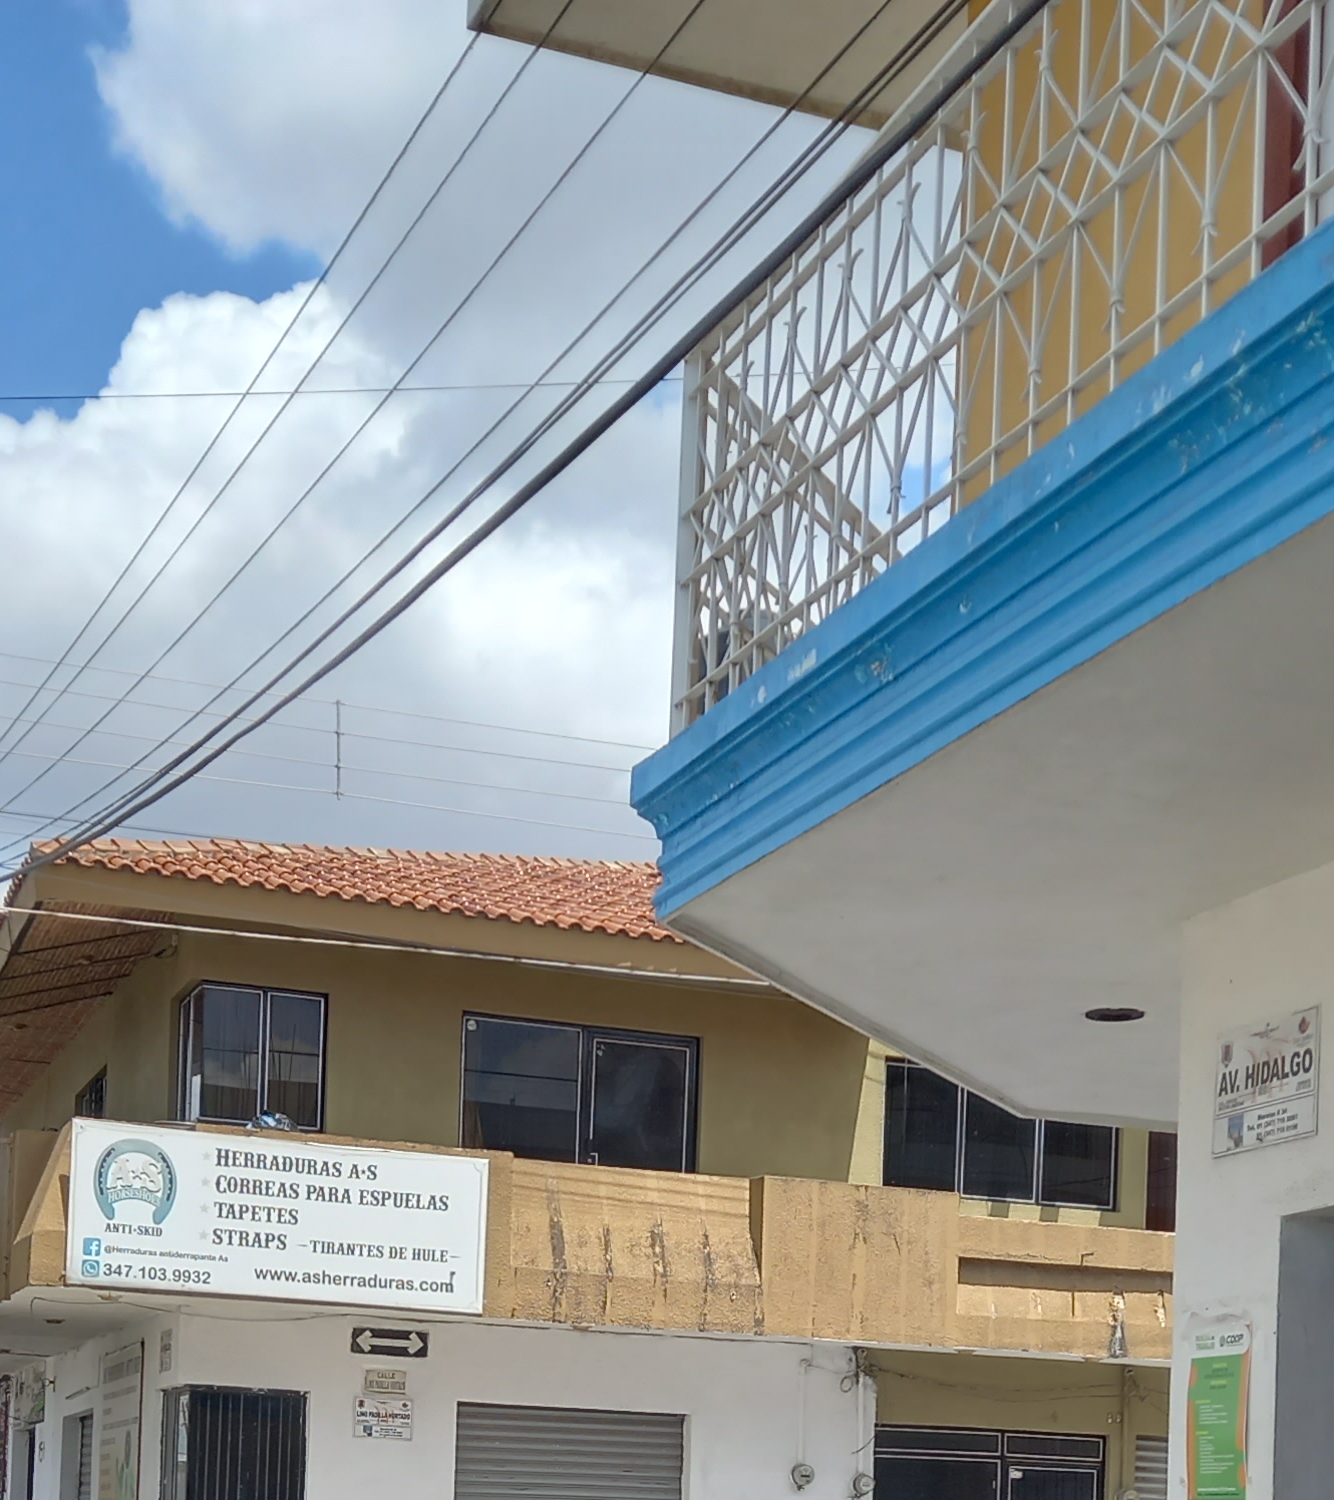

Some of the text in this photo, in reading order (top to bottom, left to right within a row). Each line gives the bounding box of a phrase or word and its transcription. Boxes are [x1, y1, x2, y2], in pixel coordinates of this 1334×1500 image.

[1218, 1048, 1313, 1097] AV. HIDALGO
[214, 1148, 343, 1178] HERRADURAS
[215, 1175, 449, 1211] CORREAS PARA ESPUELAS
[214, 1202, 299, 1225] TAPETES
[212, 1228, 287, 1250] STRAPS
[388, 1246, 407, 1260] DE
[103, 1263, 212, 1285] 347.103.9932
[254, 1268, 455, 1294] www.asherraduras.com
